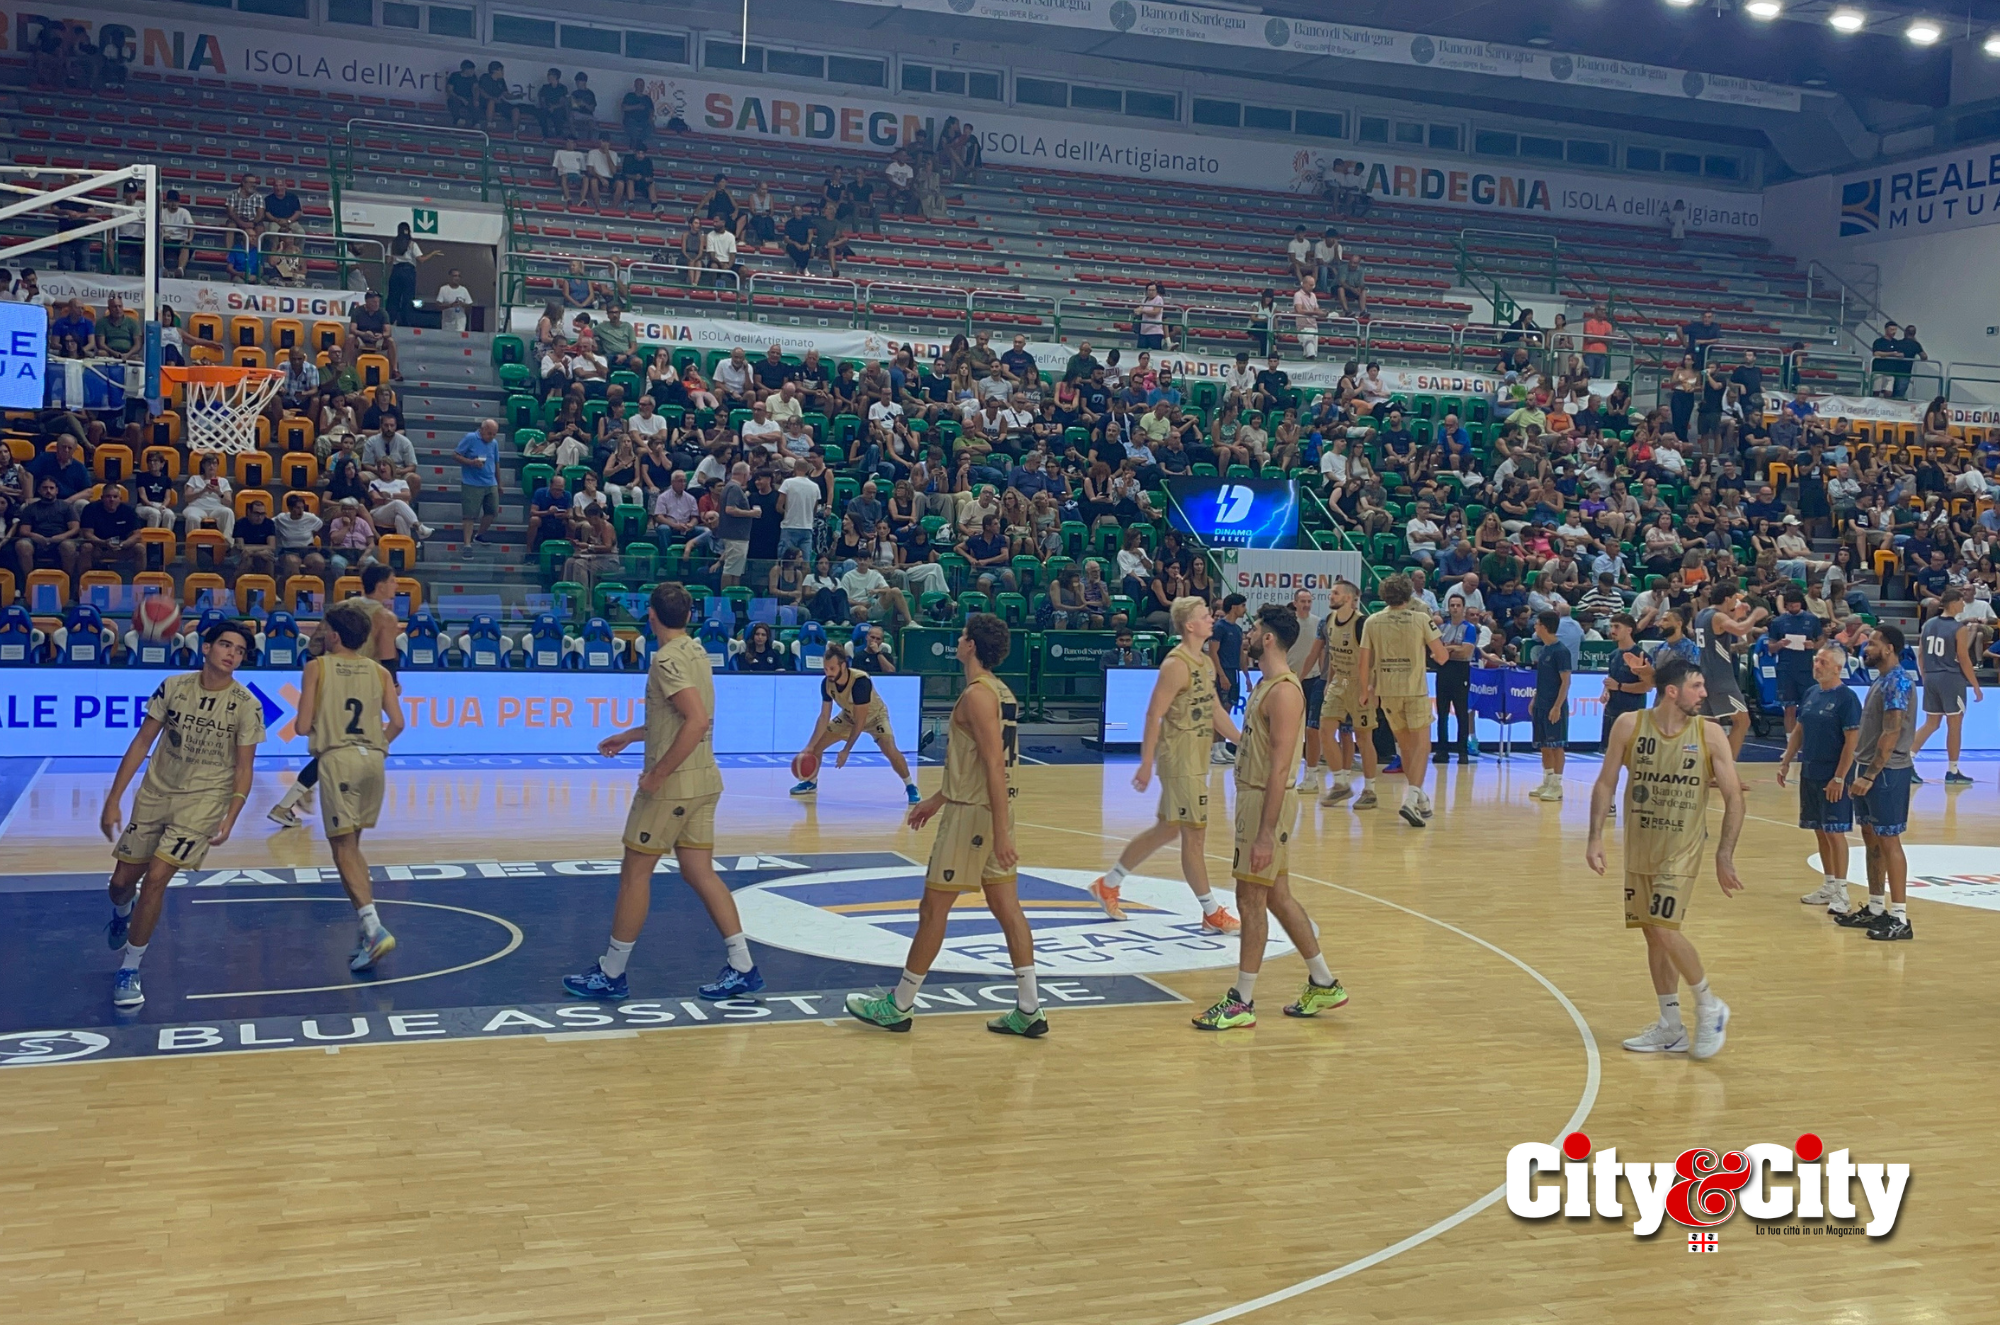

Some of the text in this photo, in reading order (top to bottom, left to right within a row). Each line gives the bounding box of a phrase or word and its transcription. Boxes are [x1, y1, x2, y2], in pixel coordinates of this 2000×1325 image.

[1141, 5, 1247, 30] Banco di Sardegna
[244, 48, 331, 79] ISOLA
[1054, 139, 1219, 174] dell'Artigianato
[1562, 189, 1618, 213] ISOLA
[698, 330, 732, 343] ISOLA
[1214, 528, 1253, 536] DINAMO
[1926, 634, 1945, 658] 10
[1470, 683, 1498, 696] molten
[199, 696, 216, 711] 11
[497, 697, 574, 728] PER
[183, 714, 235, 733] REALE
[344, 697, 364, 735] 2
[1361, 715, 1368, 726] 3
[1637, 736, 1656, 756] 30
[1652, 785, 1695, 799] Banco di
[1651, 797, 1697, 811] Sardegna
[1652, 817, 1684, 828] REALE
[170, 837, 196, 860] 11
[1650, 893, 1676, 919] 30
[157, 1013, 447, 1051] BLUE
